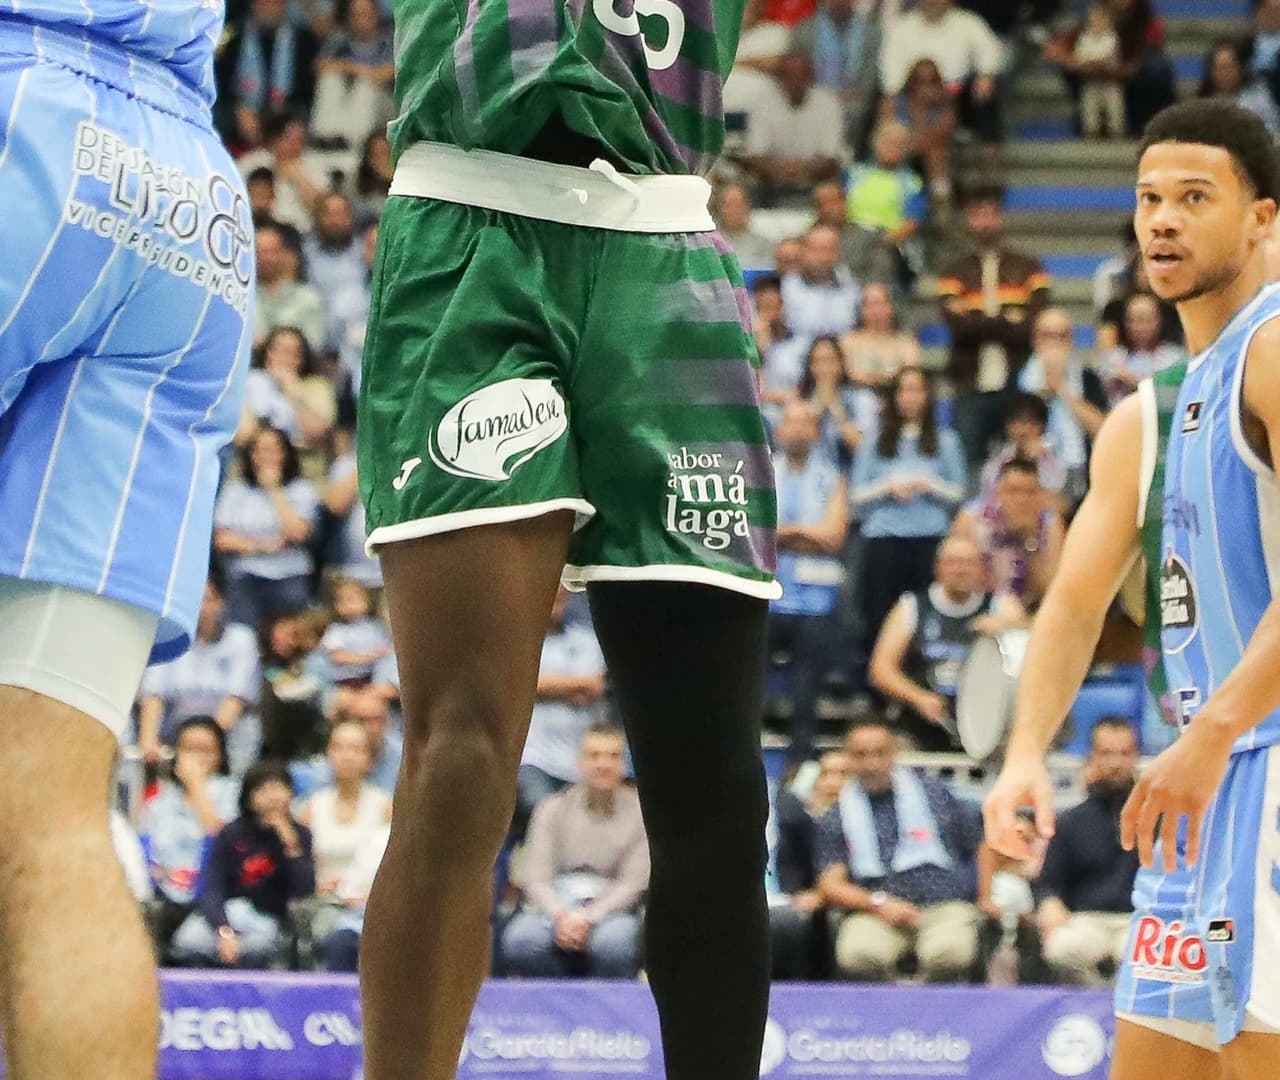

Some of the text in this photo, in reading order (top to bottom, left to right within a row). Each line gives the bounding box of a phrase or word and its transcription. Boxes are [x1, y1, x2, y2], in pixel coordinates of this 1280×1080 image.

[76, 148, 112, 180] DE
[665, 494, 751, 551] laga
[1133, 917, 1208, 971] Río
